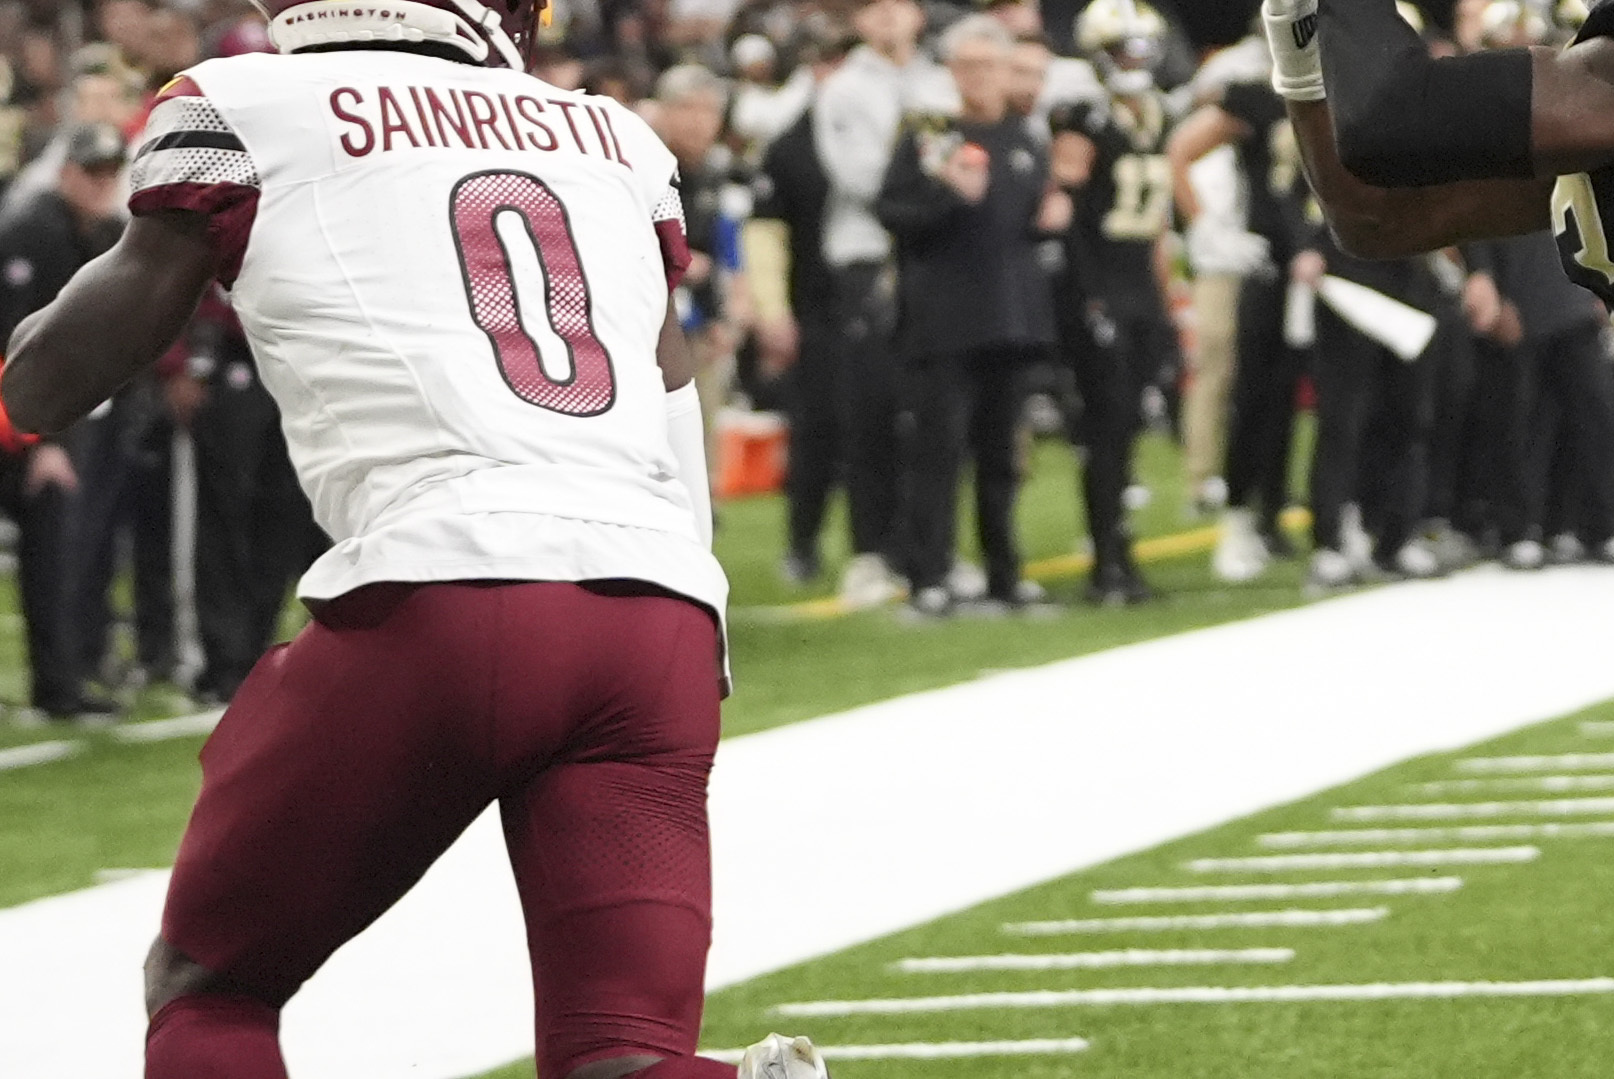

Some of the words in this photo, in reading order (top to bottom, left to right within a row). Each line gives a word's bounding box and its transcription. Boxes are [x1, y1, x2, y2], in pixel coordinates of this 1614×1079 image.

[285, 8, 406, 26] WASHINGTON
[329, 86, 634, 172] SAINRISTIL
[448, 168, 616, 418] 0
